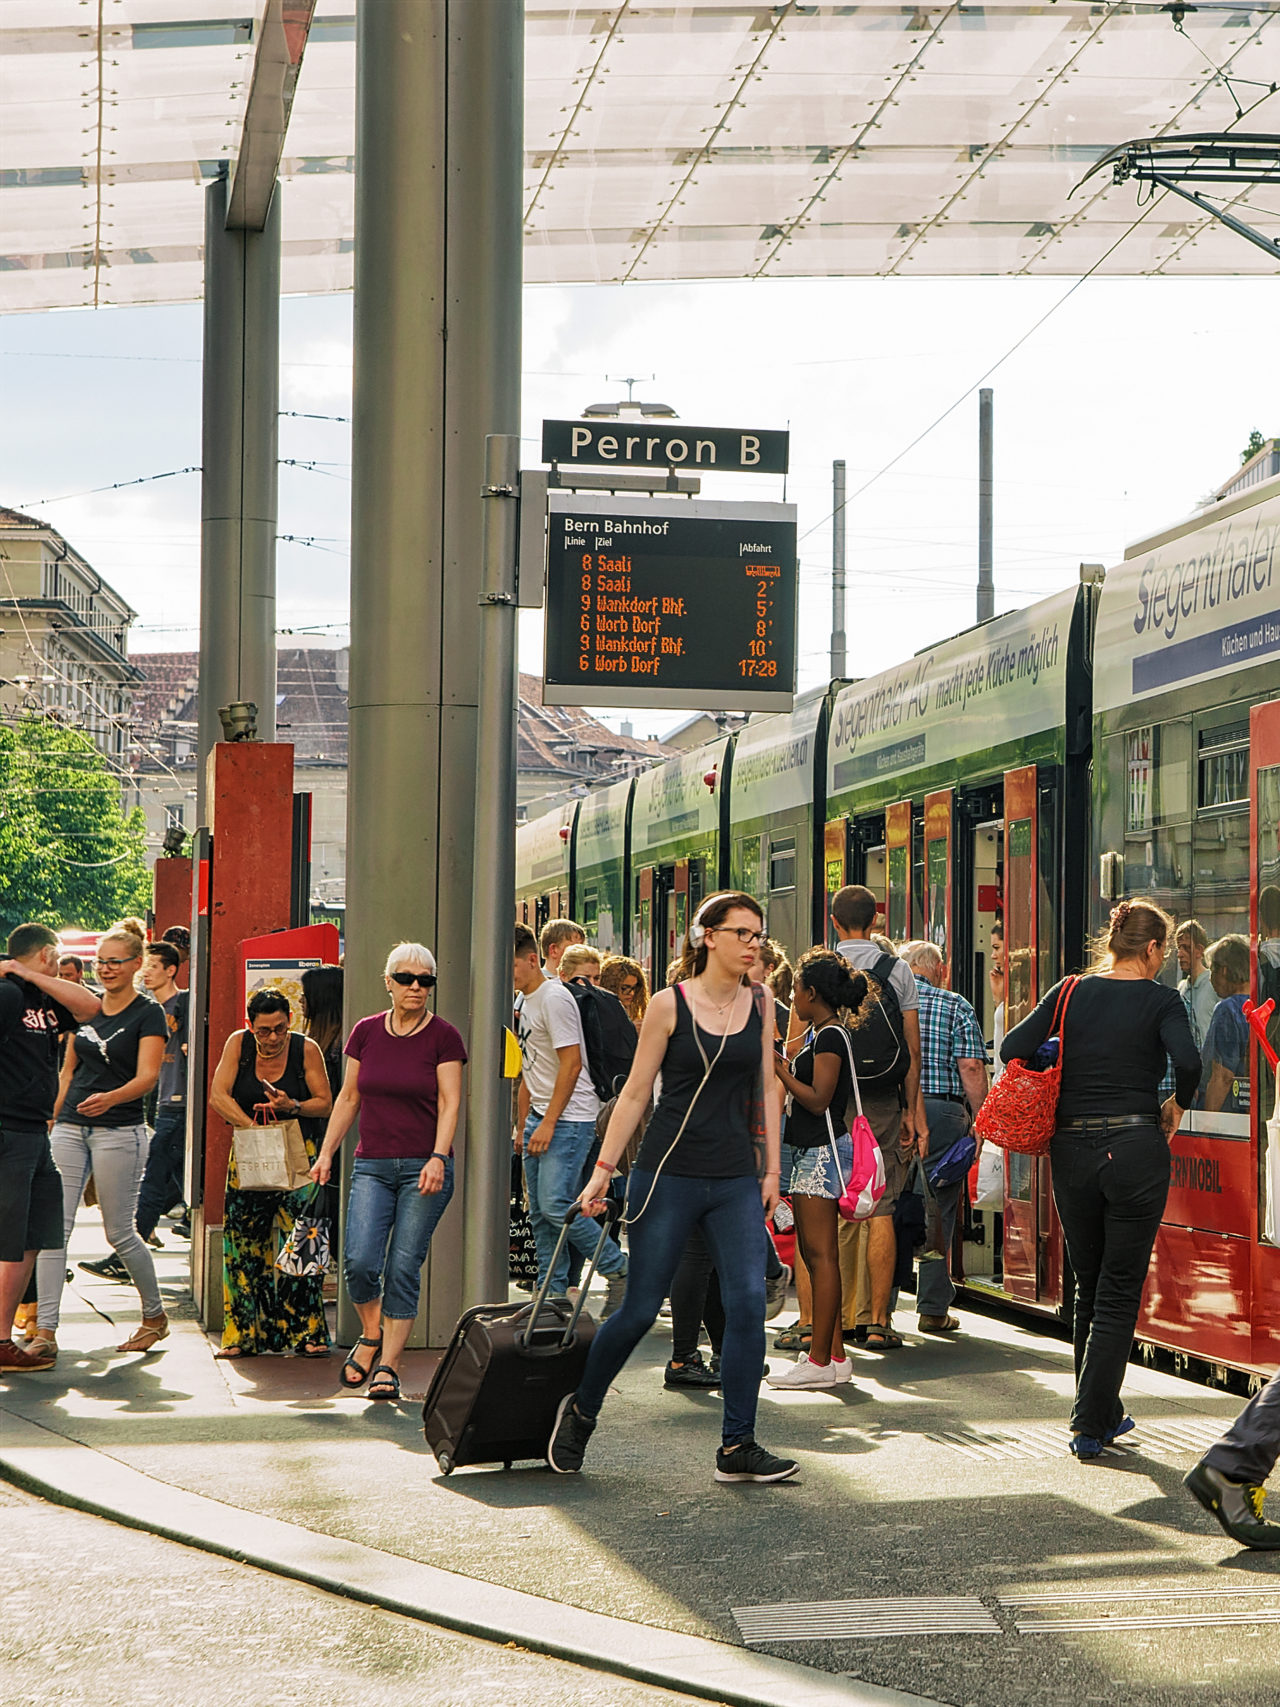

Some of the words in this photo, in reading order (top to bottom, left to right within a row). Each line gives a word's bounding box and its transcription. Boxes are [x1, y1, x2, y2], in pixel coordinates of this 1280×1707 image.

[570, 427, 717, 463] Perron
[740, 435, 761, 465] B
[564, 518, 600, 533] Bern
[604, 519, 670, 535] Bahnhof
[567, 536, 587, 546] Linie
[598, 537, 613, 547] Ziel
[742, 543, 772, 553] Abfahrt
[582, 554, 592, 571] 8
[598, 554, 632, 573] Saali
[581, 574, 591, 591] 8
[597, 574, 631, 593] Saali
[757, 581, 774, 598] 2'
[581, 594, 591, 611] 9
[596, 595, 659, 616] Wankdorf
[662, 597, 688, 617] Bhf.
[756, 601, 774, 618] 5'
[580, 614, 590, 631] 6
[596, 614, 629, 633] Worb
[632, 616, 662, 636] Dorf
[756, 620, 773, 637] 8'
[580, 634, 590, 651] 9
[595, 634, 658, 656] Wankdorf
[661, 637, 686, 656] Bhf.
[748, 640, 773, 656] 10'
[1221, 633, 1248, 657] Küchen
[1249, 624, 1264, 649] und
[579, 654, 590, 671] 6
[595, 654, 628, 672] Worb
[631, 655, 661, 676] Dorf
[738, 659, 777, 677] 17:28
[834, 671, 910, 754] Siegenthaler
[907, 655, 935, 721] AG
[935, 664, 964, 710] macht
[962, 655, 985, 712] jede
[985, 643, 1016, 692] Küche
[1016, 622, 1059, 686] möglich
[1169, 1155, 1223, 1194] ERNMOBIL
